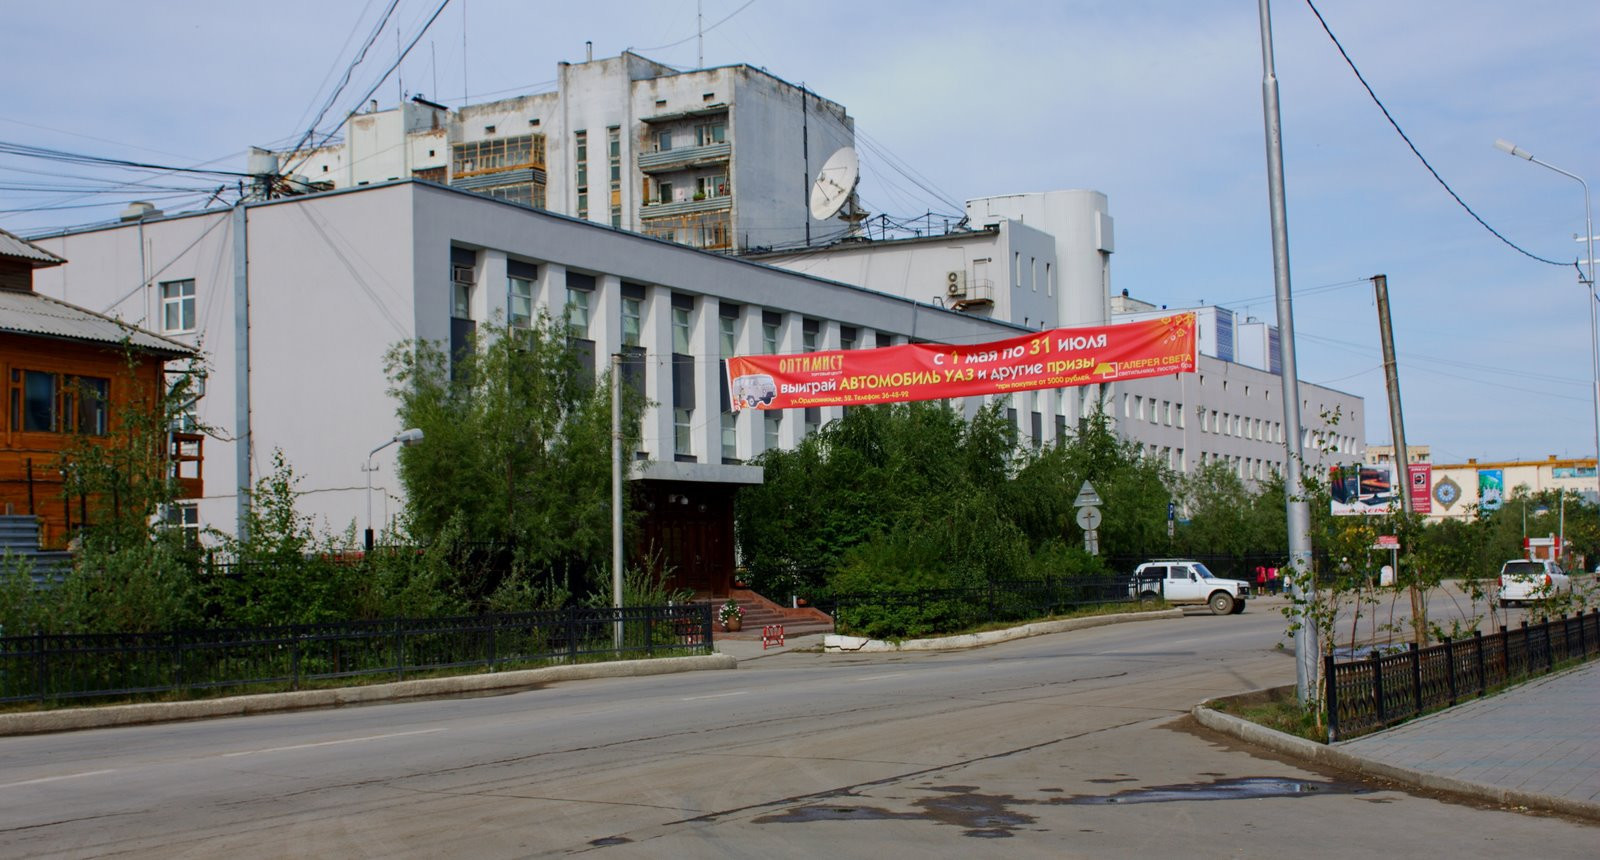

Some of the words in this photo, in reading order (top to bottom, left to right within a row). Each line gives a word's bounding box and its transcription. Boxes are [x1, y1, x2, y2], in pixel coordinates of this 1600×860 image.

[951, 350, 959, 365] 1
[965, 350, 998, 364] мая
[1002, 345, 1025, 359] по
[1029, 336, 1050, 355] 31
[779, 355, 844, 373] ОПТИМИСТ
[1118, 357, 1160, 369] ГАЛЕРЕЯ
[1162, 353, 1193, 365] СВЕТА
[780, 378, 837, 395] выиграй
[840, 370, 941, 390] АВТОМОБИЛЬ
[944, 367, 974, 383] УАЗ
[977, 369, 987, 379] и
[990, 363, 1043, 381] другие
[1047, 357, 1095, 375] призы
[1047, 377, 1064, 385] 5000
